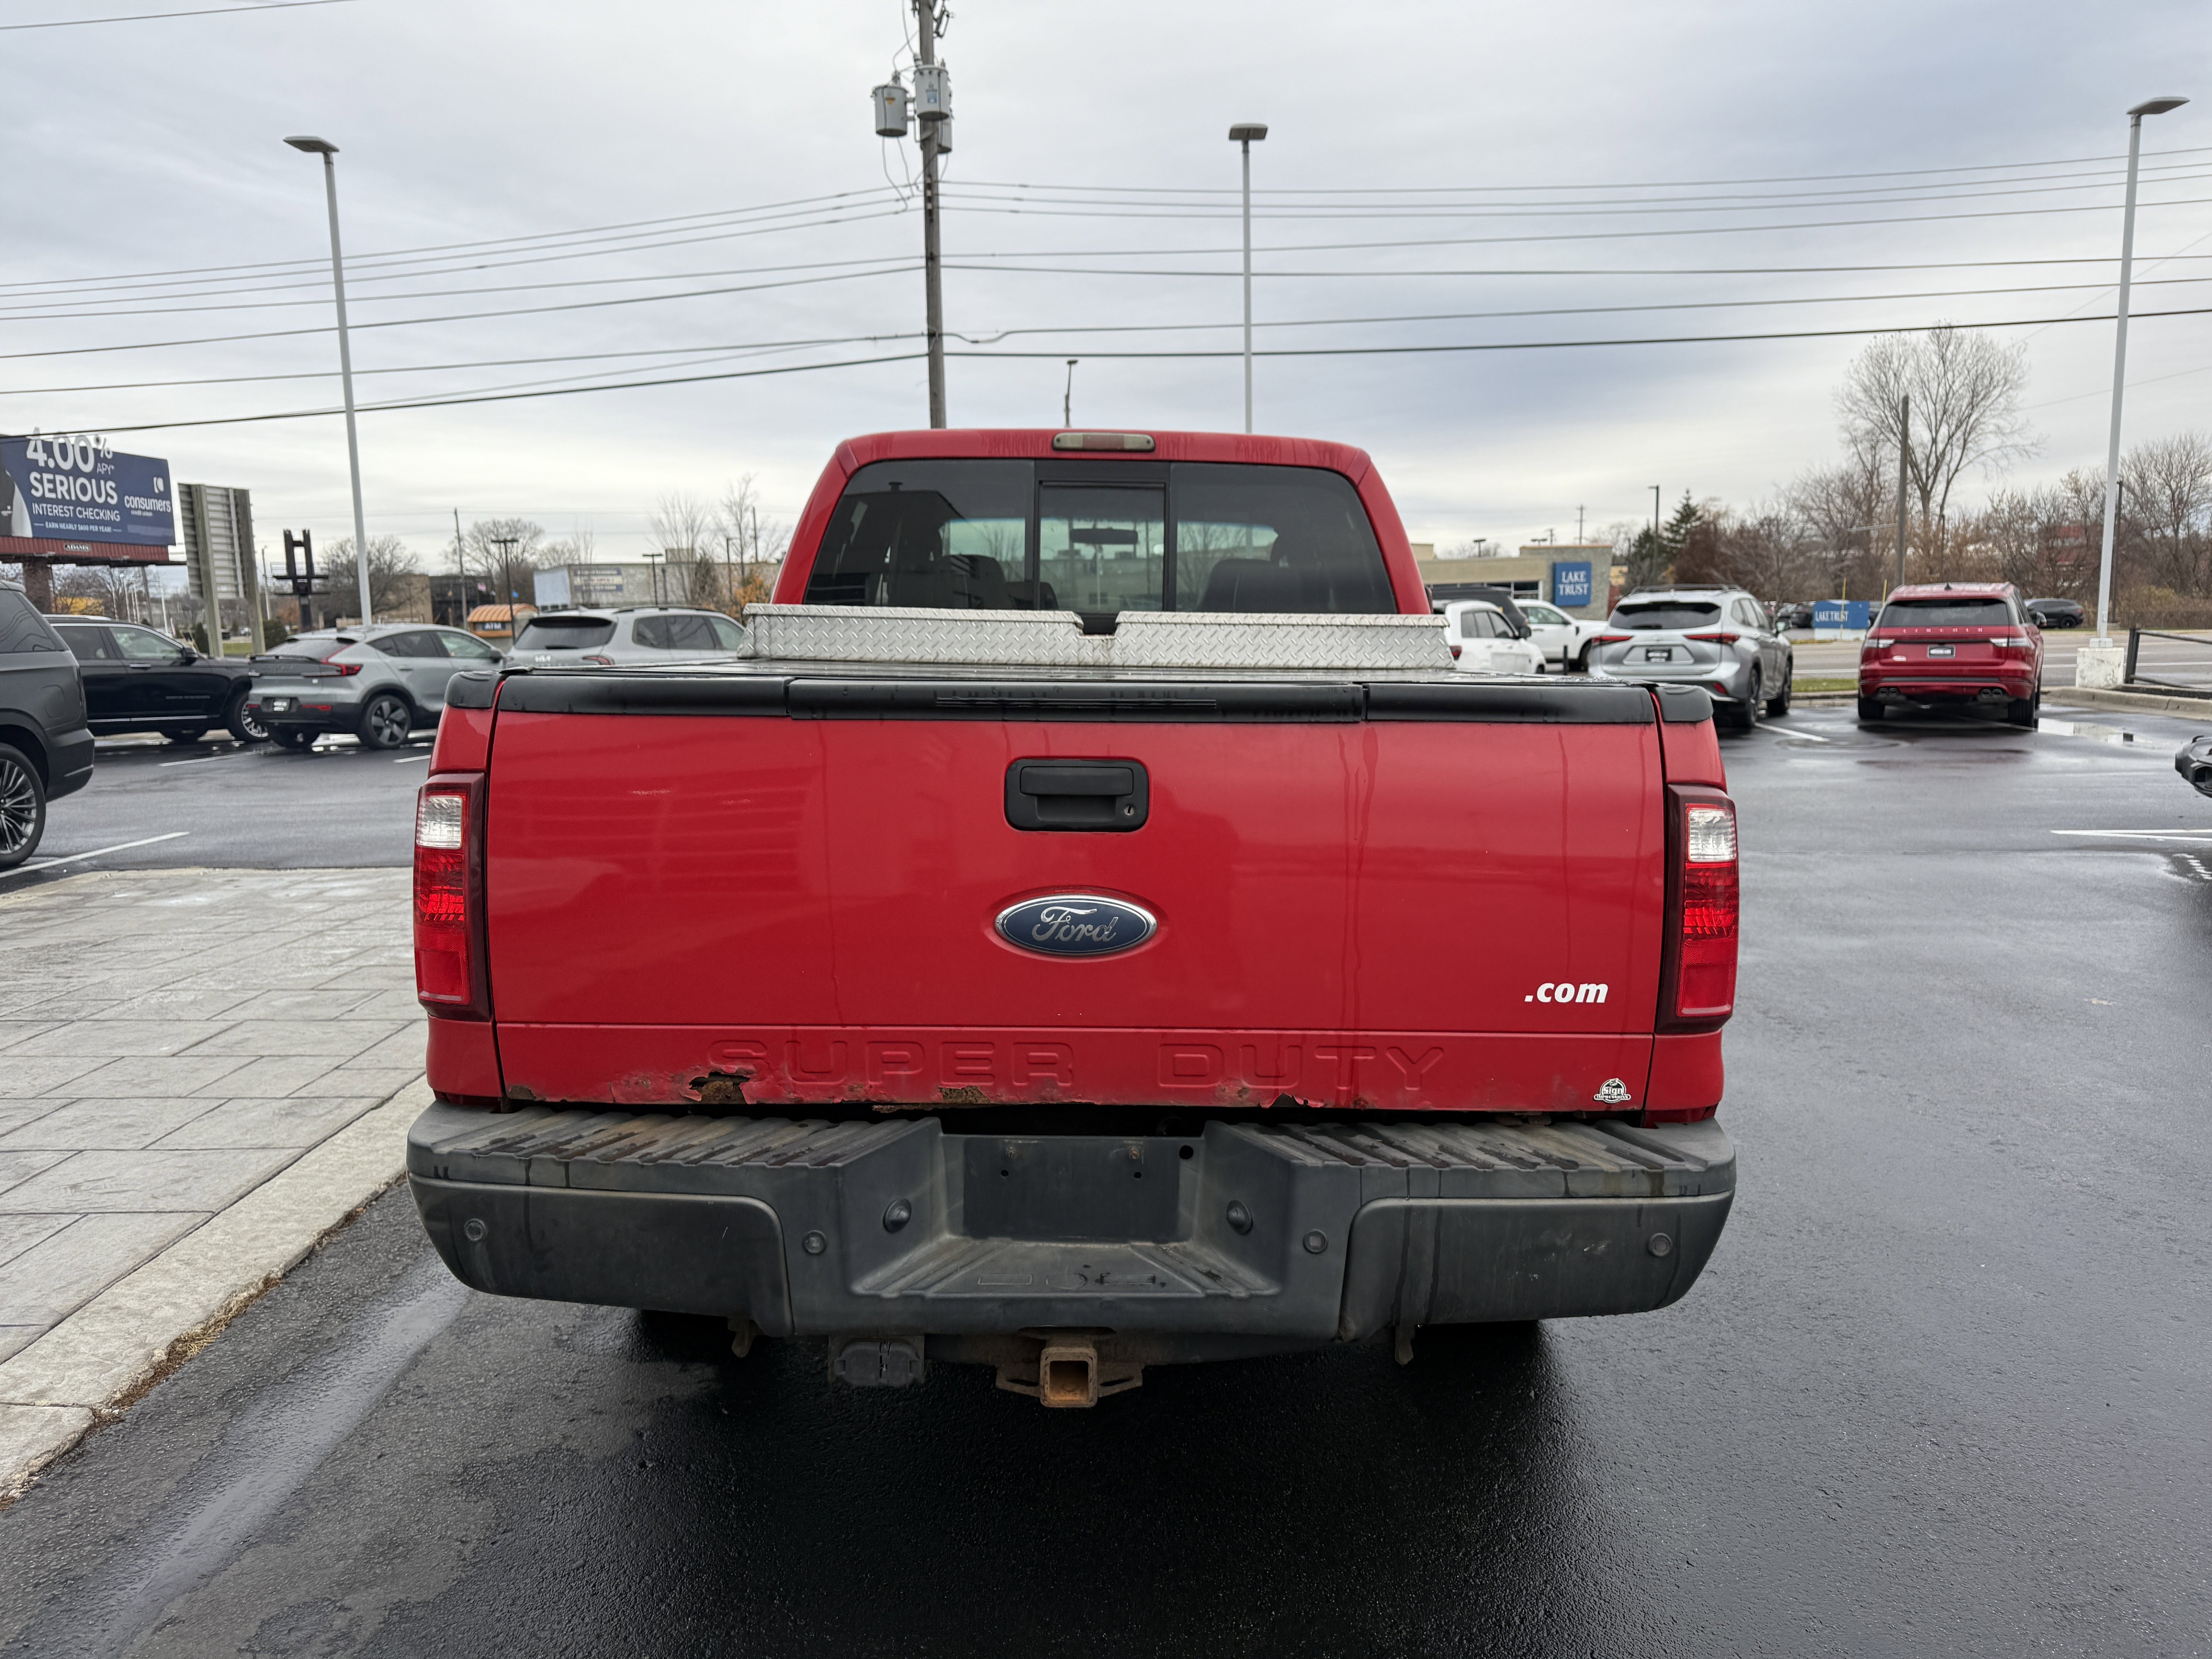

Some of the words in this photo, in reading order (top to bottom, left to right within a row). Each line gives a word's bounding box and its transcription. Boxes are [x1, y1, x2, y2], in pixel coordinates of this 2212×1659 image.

[29, 472, 118, 505] SERIOUS
[33, 503, 74, 517] INTEREST
[76, 507, 120, 521] CHECKING
[124, 496, 171, 512] consumers
[1562, 571, 1586, 583] LAKE
[1558, 583, 1589, 596] TRUST
[1815, 611, 1829, 622] LAKE
[484, 622, 502, 630] ATM
[1032, 907, 1118, 941] Ford
[1524, 983, 1608, 1003] .com
[708, 1040, 1073, 1086] SUPER
[1158, 1044, 1444, 1091] DUTY
[1603, 1086, 1623, 1096] Sign
